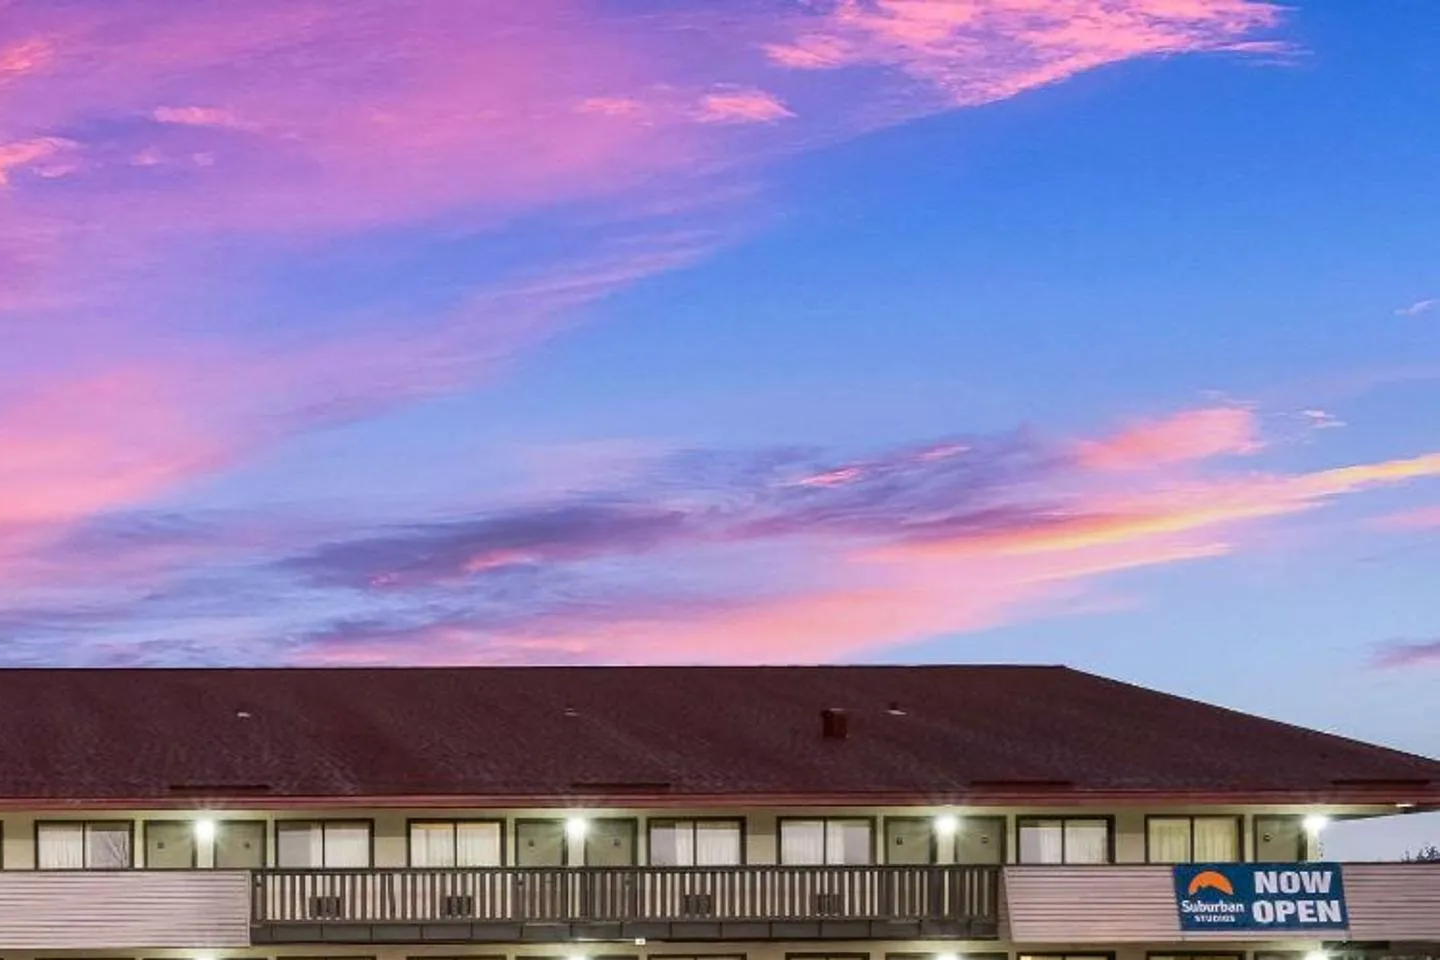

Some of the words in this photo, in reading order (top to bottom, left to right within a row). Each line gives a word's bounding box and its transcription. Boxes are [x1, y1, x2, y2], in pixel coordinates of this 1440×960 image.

[1253, 871, 1332, 894] NOW
[1181, 900, 1245, 913] Suburban
[1252, 900, 1342, 923] OPEN
